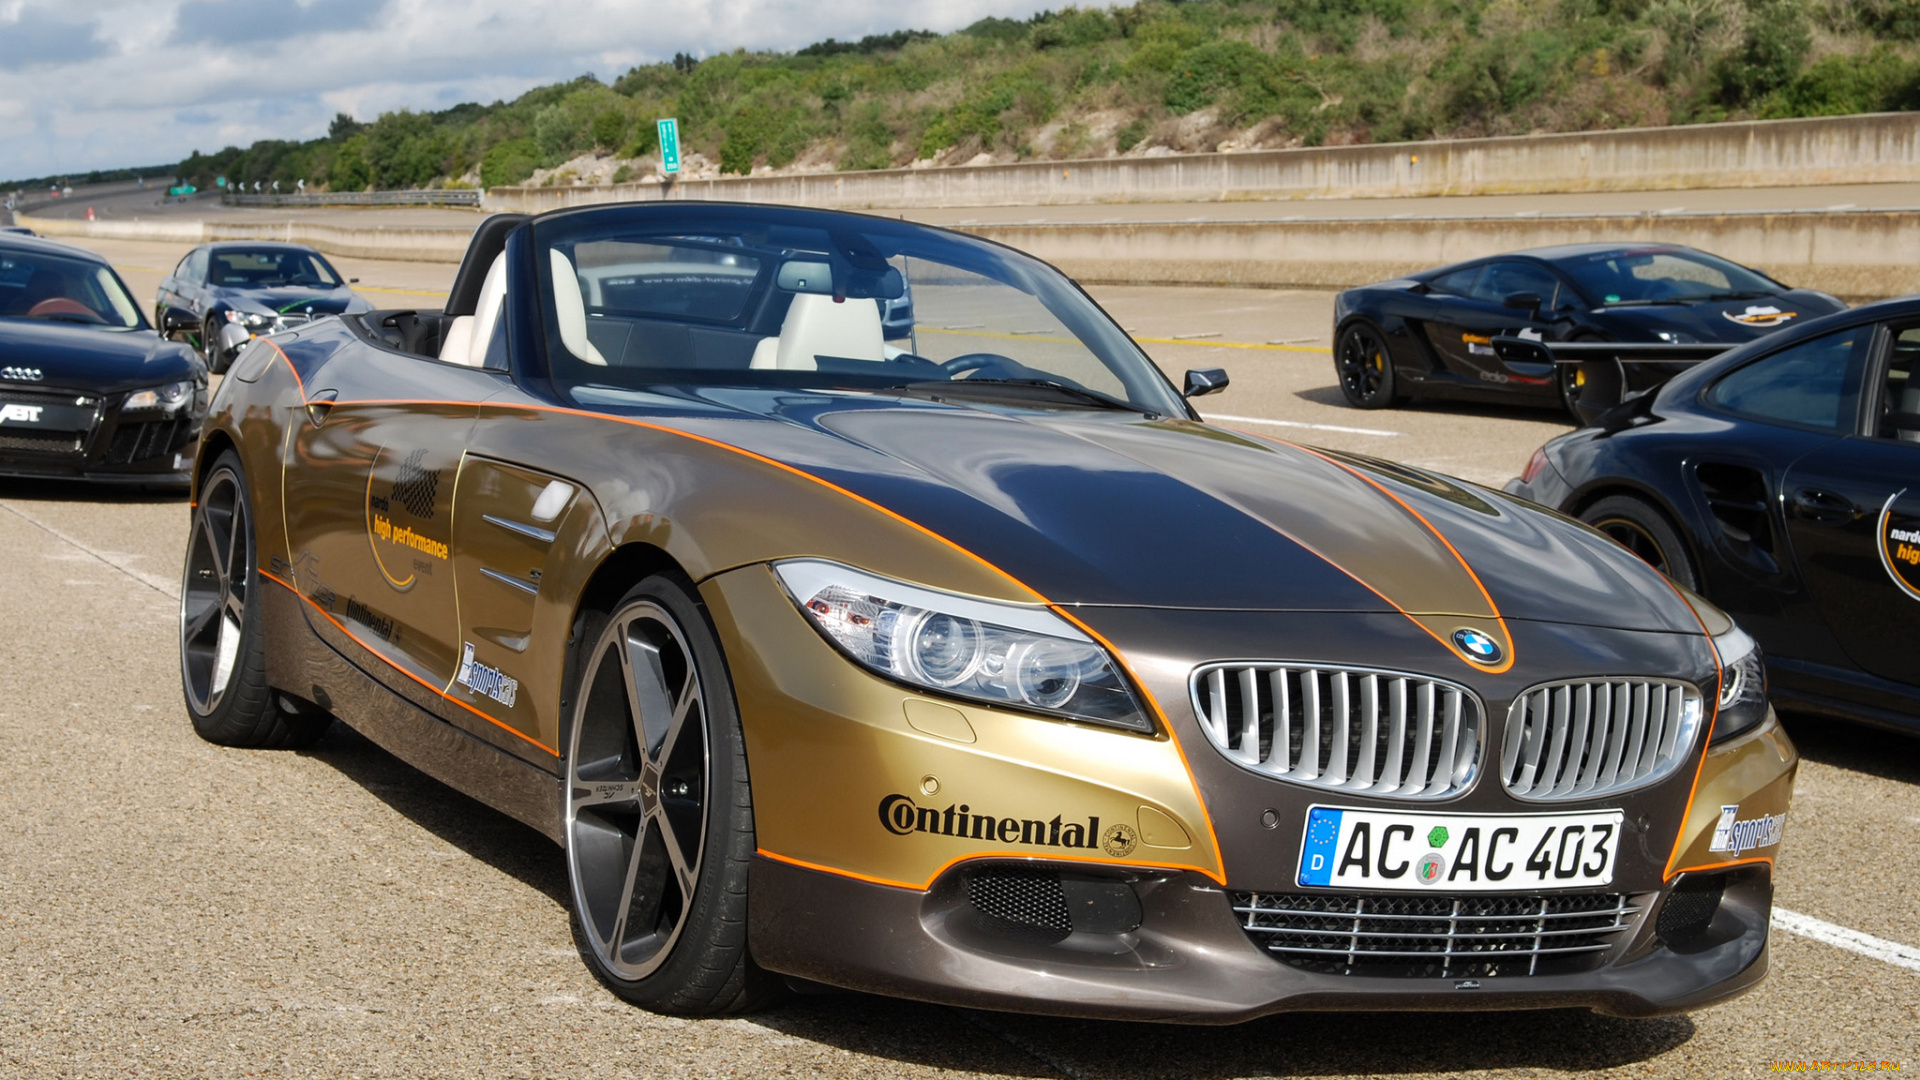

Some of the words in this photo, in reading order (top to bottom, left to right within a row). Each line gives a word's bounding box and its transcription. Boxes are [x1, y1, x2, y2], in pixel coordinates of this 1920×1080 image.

[374, 513, 391, 541] high
[392, 525, 449, 560] performance
[1896, 542, 1920, 565] hig
[878, 793, 1100, 850] Continental
[1311, 853, 1325, 871] D
[1338, 822, 1414, 880] AC
[1448, 827, 1519, 882] AC
[1526, 824, 1614, 880] 403
